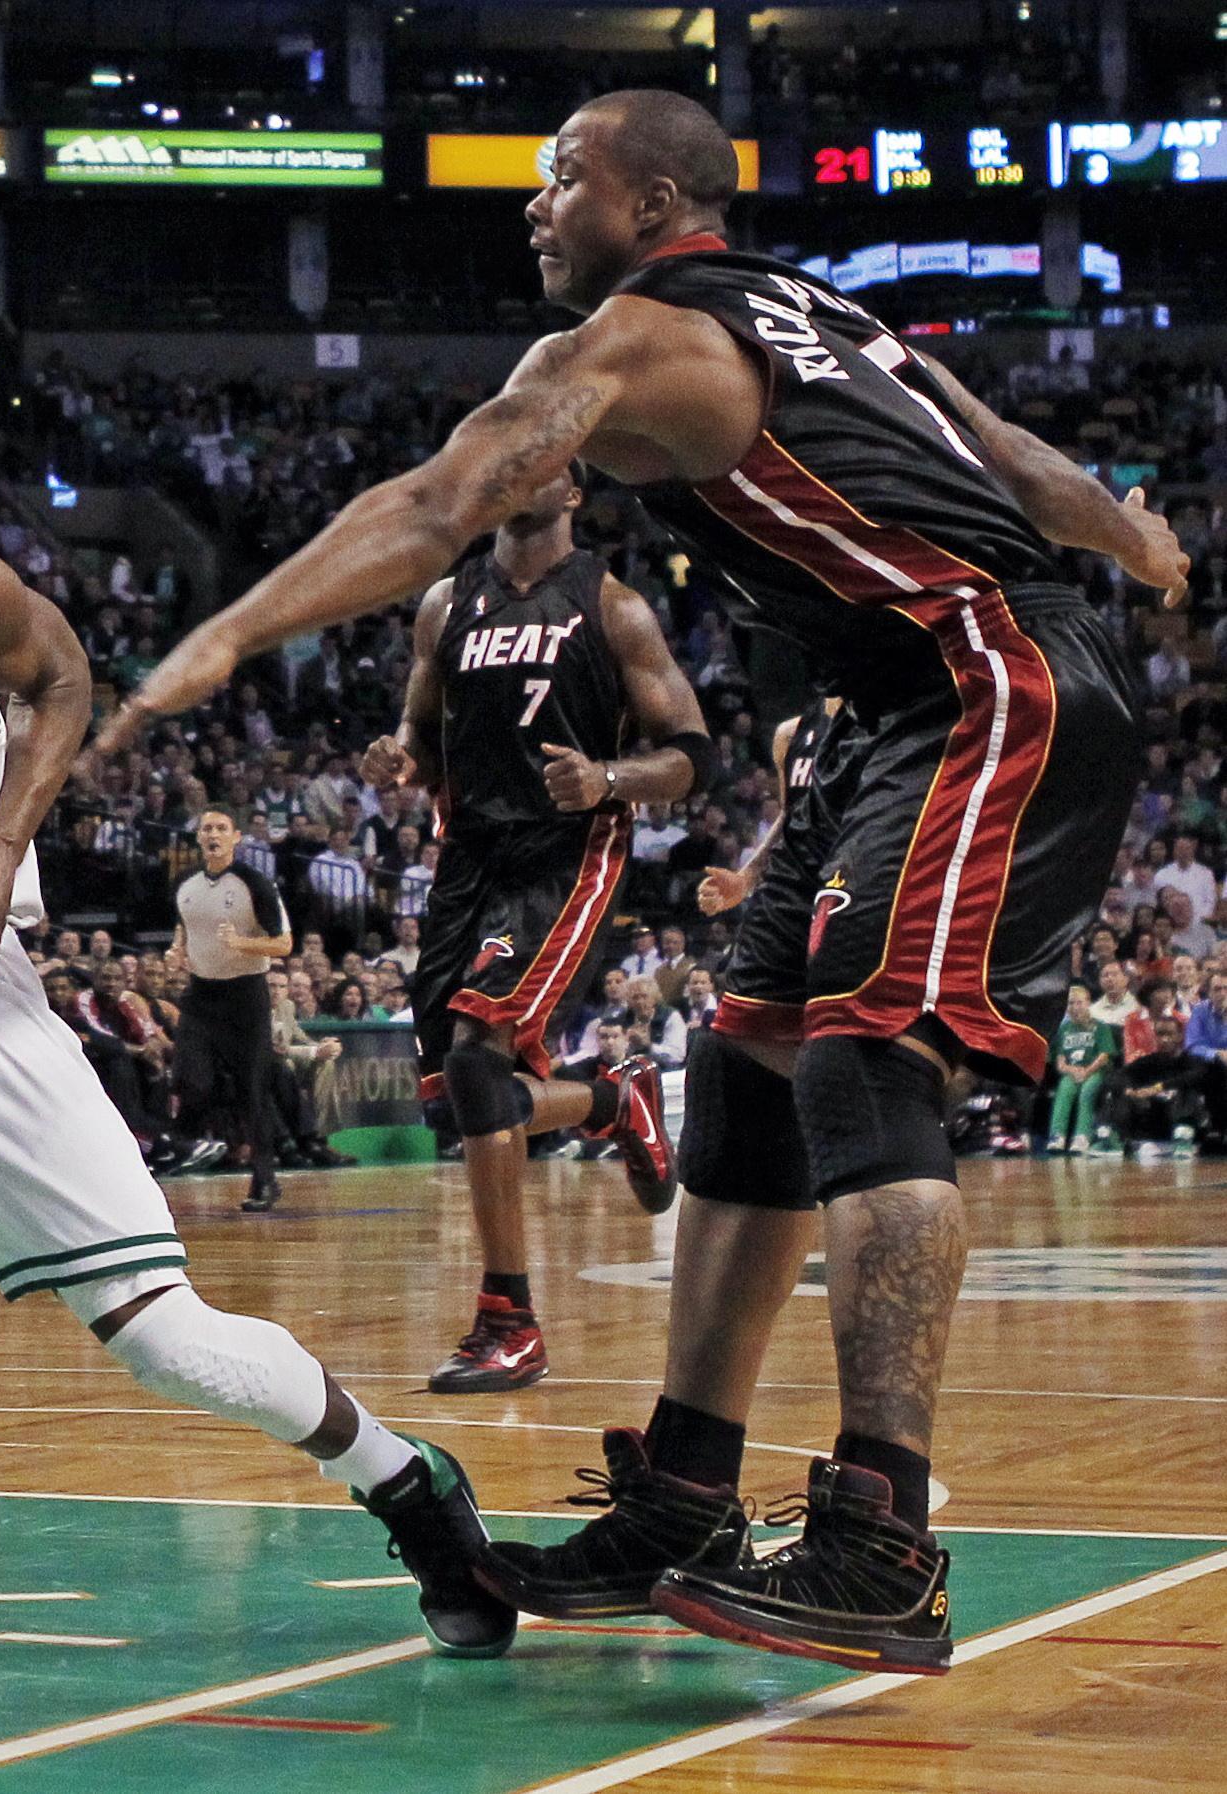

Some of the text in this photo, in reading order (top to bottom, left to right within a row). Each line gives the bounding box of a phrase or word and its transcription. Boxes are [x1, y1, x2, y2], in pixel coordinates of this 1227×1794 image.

[1160, 119, 1222, 151] AST
[814, 146, 871, 184] 21
[1085, 150, 1201, 185] 3 2
[458, 613, 584, 672] HEAT
[518, 679, 551, 727] 7
